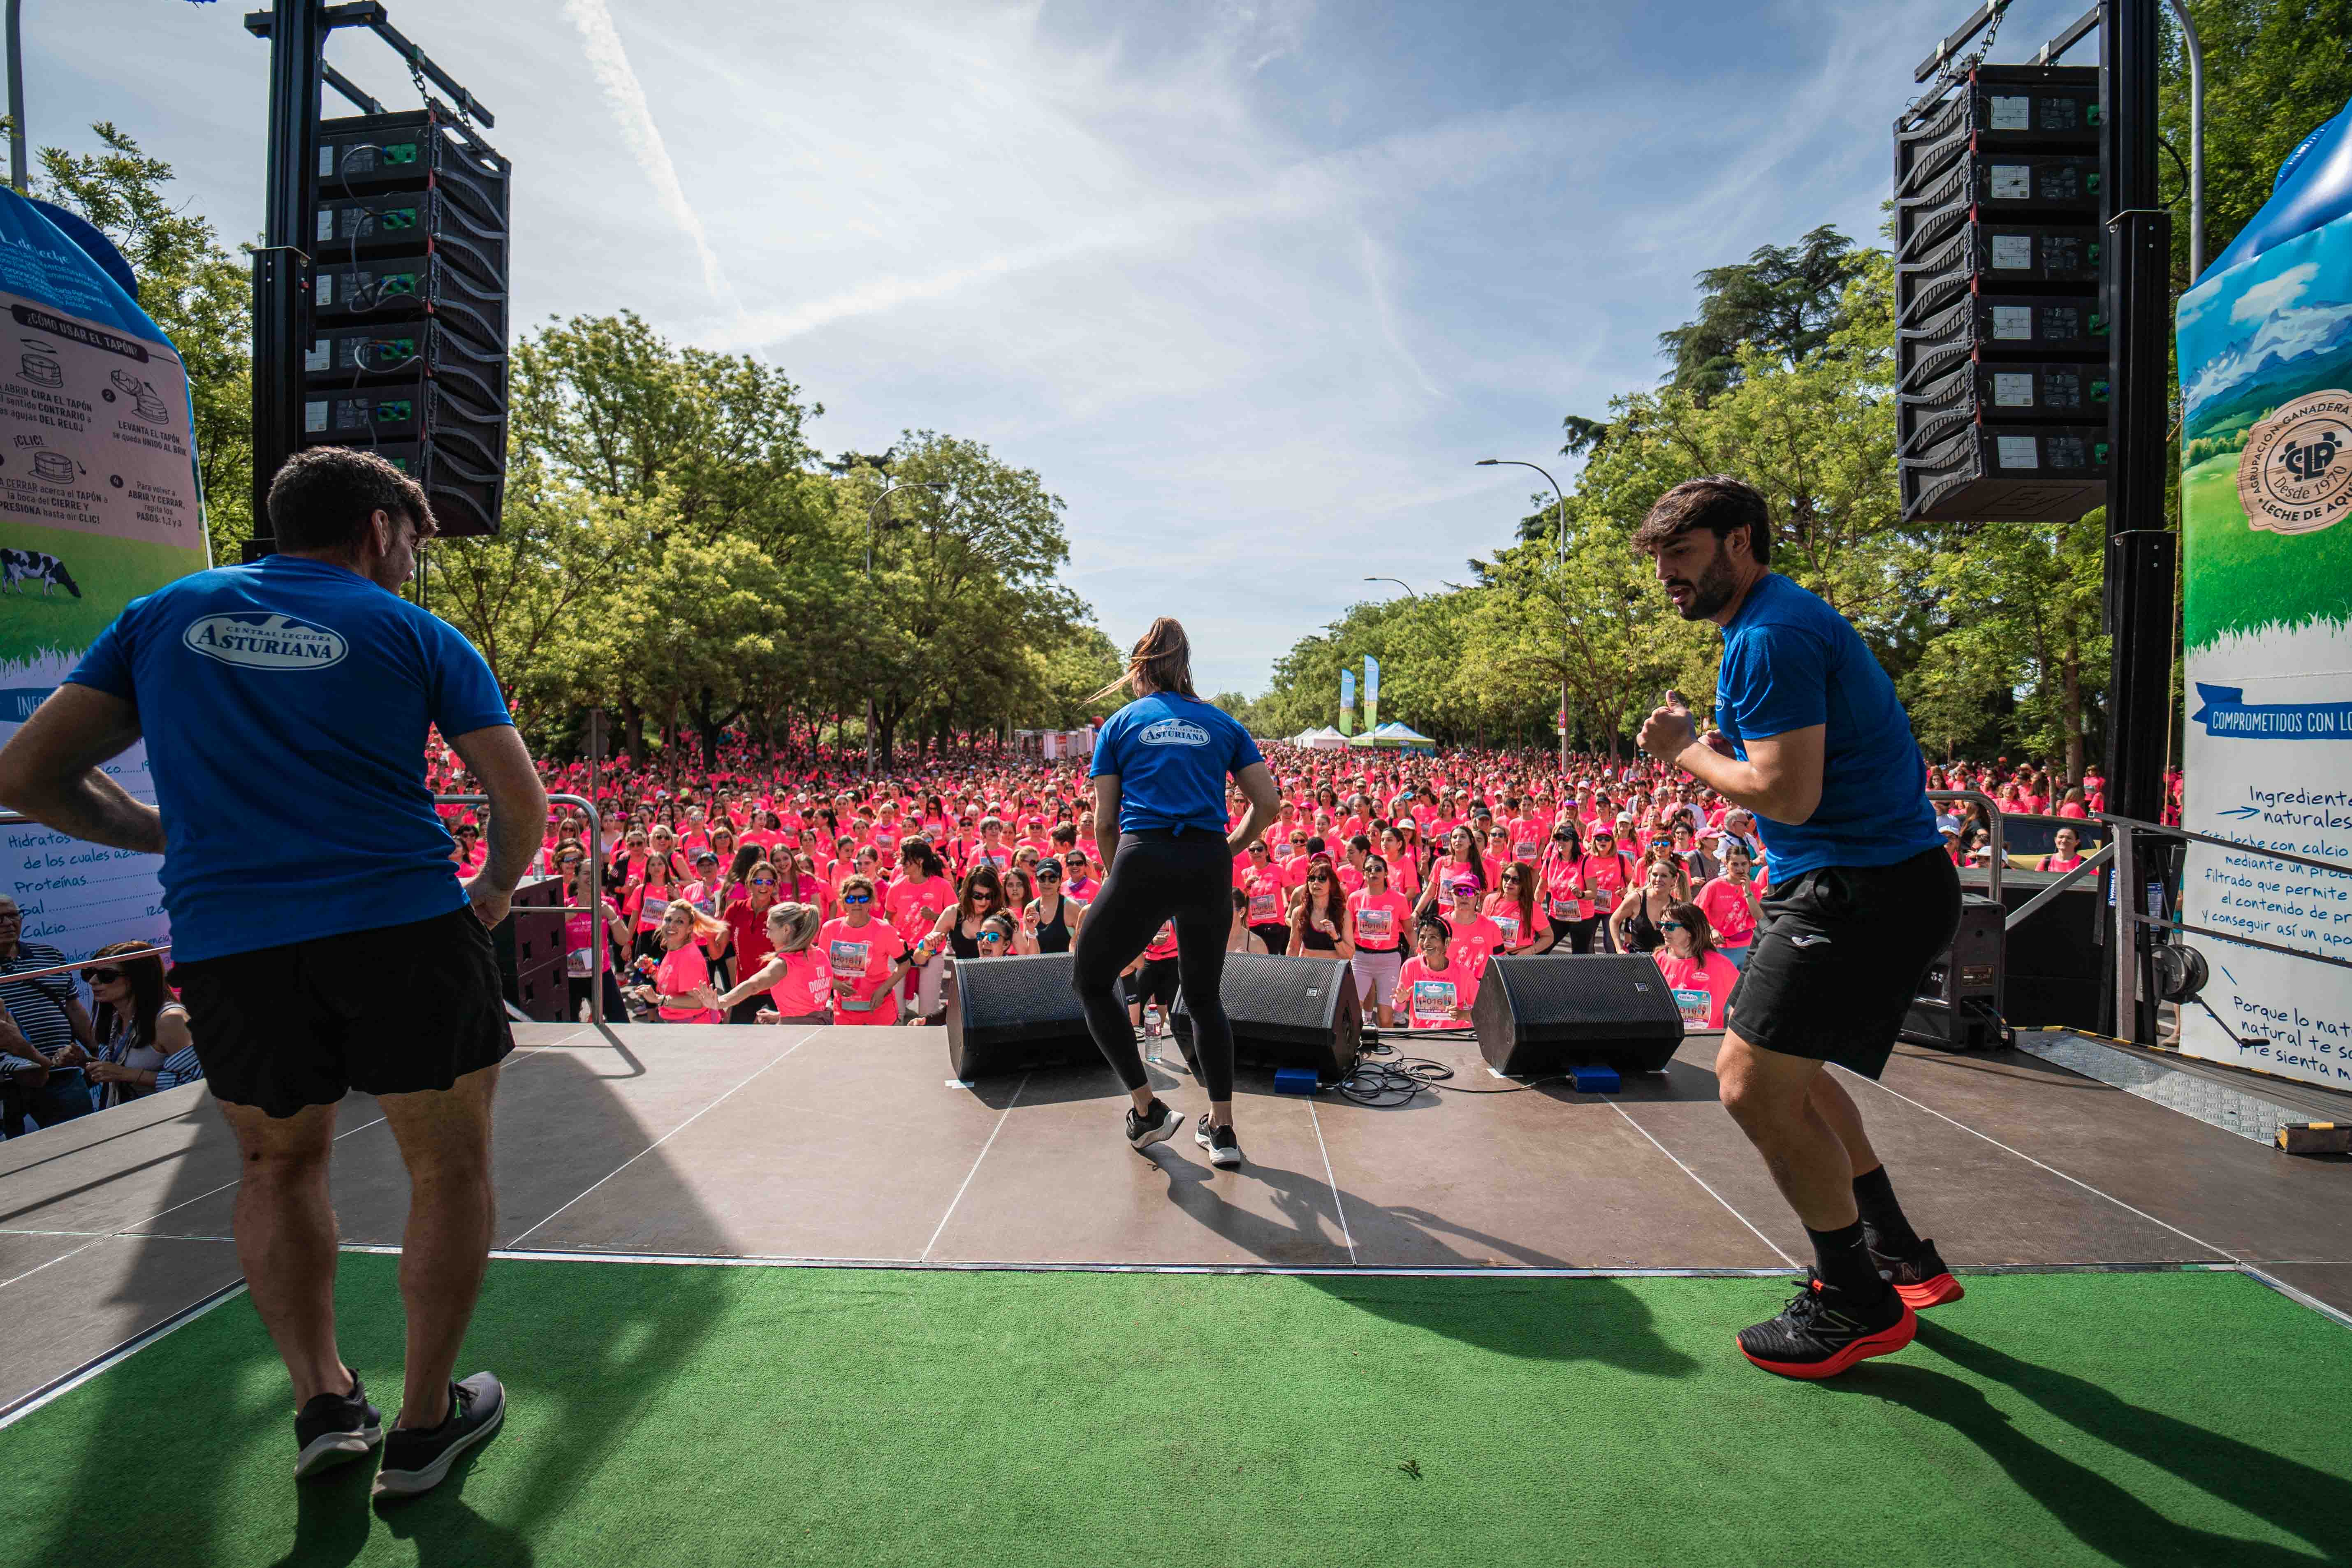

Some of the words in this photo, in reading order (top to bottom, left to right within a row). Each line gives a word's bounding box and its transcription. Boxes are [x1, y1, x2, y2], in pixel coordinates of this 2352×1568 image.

[27, 313, 57, 330] ¿CÓMO
[60, 323, 87, 340] USAR
[89, 333, 102, 345] EL
[104, 337, 138, 357] TAPÓN?
[5, 383, 29, 396] ABRIR
[31, 390, 51, 403] GIRA
[54, 395, 65, 405] EL
[66, 398, 92, 412] TAPÓN
[7, 397, 36, 410] sentido
[38, 403, 86, 422] CONTRARIO
[11, 410, 37, 422] agujas
[39, 415, 55, 426] DEL
[58, 419, 83, 433] RELOJ
[118, 420, 148, 435] LEVANTA
[151, 430, 158, 438] EL
[13, 434, 44, 448] ¡CLIC!
[143, 438, 162, 449] UNIDO
[164, 444, 171, 452] AL
[173, 445, 187, 456] BRIK
[2250, 426, 2280, 494] AGRUPACIÓN
[2282, 402, 2350, 425] GANADERA
[6, 478, 37, 492] CERRAR
[40, 486, 65, 496] acerca
[76, 491, 102, 503] TAPÓN
[137, 481, 152, 491] Para
[2273, 476, 2310, 499] Desde
[2314, 466, 2347, 496] 1970
[17, 492, 35, 503] boca
[38, 496, 49, 505] del
[51, 497, 82, 510] CIERRE
[128, 490, 150, 501] ABRIR
[43, 508, 65, 519] hasta
[79, 513, 100, 524] CLIC!
[2261, 499, 2300, 521] LECHE
[2303, 507, 2322, 520] DE
[195, 624, 333, 659] ASTURIANA
[226, 625, 277, 637] CENTRAL
[281, 632, 331, 642] LECHERA
[2212, 711, 2302, 732] COMPROMETIDOS
[2308, 712, 2334, 732] CON
[1145, 730, 1205, 742] ASTURIANA
[9, 833, 71, 849] Hidratos
[2270, 841, 2296, 852] con
[2301, 839, 2349, 857] calcio
[23, 856, 41, 869] de
[45, 853, 65, 868] los
[70, 848, 110, 865] cuales
[2225, 853, 2283, 871] mediante
[2289, 864, 2303, 875] un
[2205, 868, 2252, 888] filtrado
[2257, 880, 2280, 893] que
[2285, 885, 2347, 901] permite
[2221, 890, 2231, 905] el
[2236, 897, 2303, 916] contenido
[2309, 904, 2327, 919] de
[2211, 912, 2271, 933] conseguir
[2277, 924, 2298, 937] así
[2301, 928, 2317, 940] un
[816, 966, 825, 977] TU
[2233, 996, 2288, 1021] Porque
[2294, 1008, 2309, 1026] lo
[2241, 1020, 2301, 1047] natural
[2308, 1035, 2331, 1053] te
[2276, 1050, 2330, 1076] sienta
